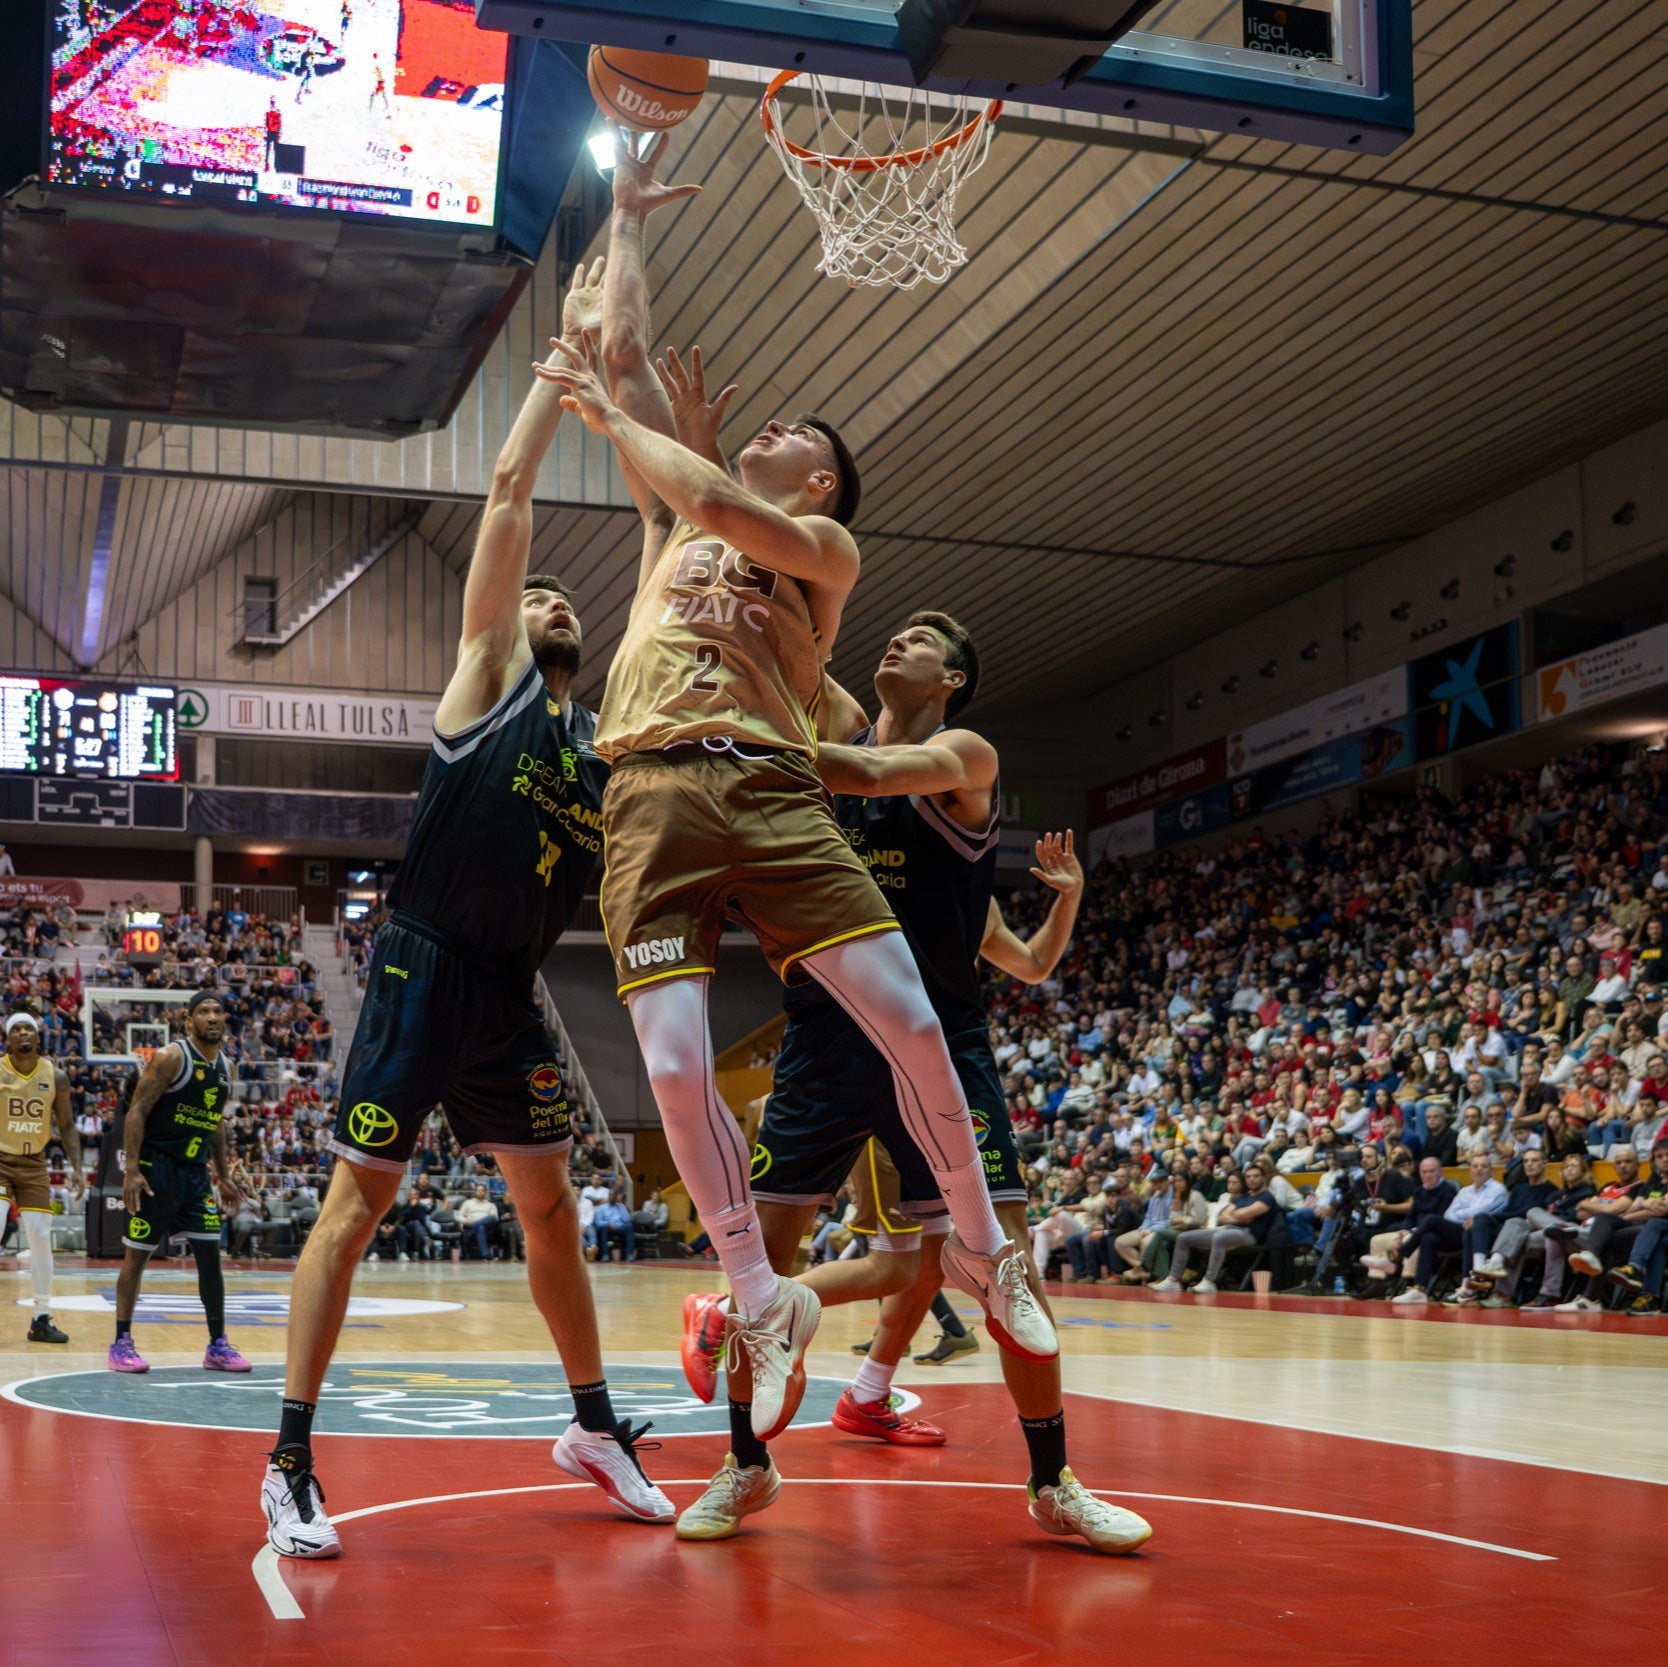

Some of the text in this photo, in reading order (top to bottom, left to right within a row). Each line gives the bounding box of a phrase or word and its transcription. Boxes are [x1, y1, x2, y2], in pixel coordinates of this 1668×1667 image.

[1247, 17, 1285, 40] liga
[615, 84, 690, 122] Wilson
[671, 540, 778, 600] BG
[660, 591, 771, 633] FIATC
[689, 643, 723, 693] 2
[266, 700, 410, 737] LLEAL TULSÀ
[131, 930, 160, 953] 10
[623, 936, 686, 969] YOSOY
[8, 1096, 46, 1120] BG
[7, 1120, 44, 1134] FIATC
[531, 1116, 552, 1130] del
[186, 1136, 203, 1158] 6
